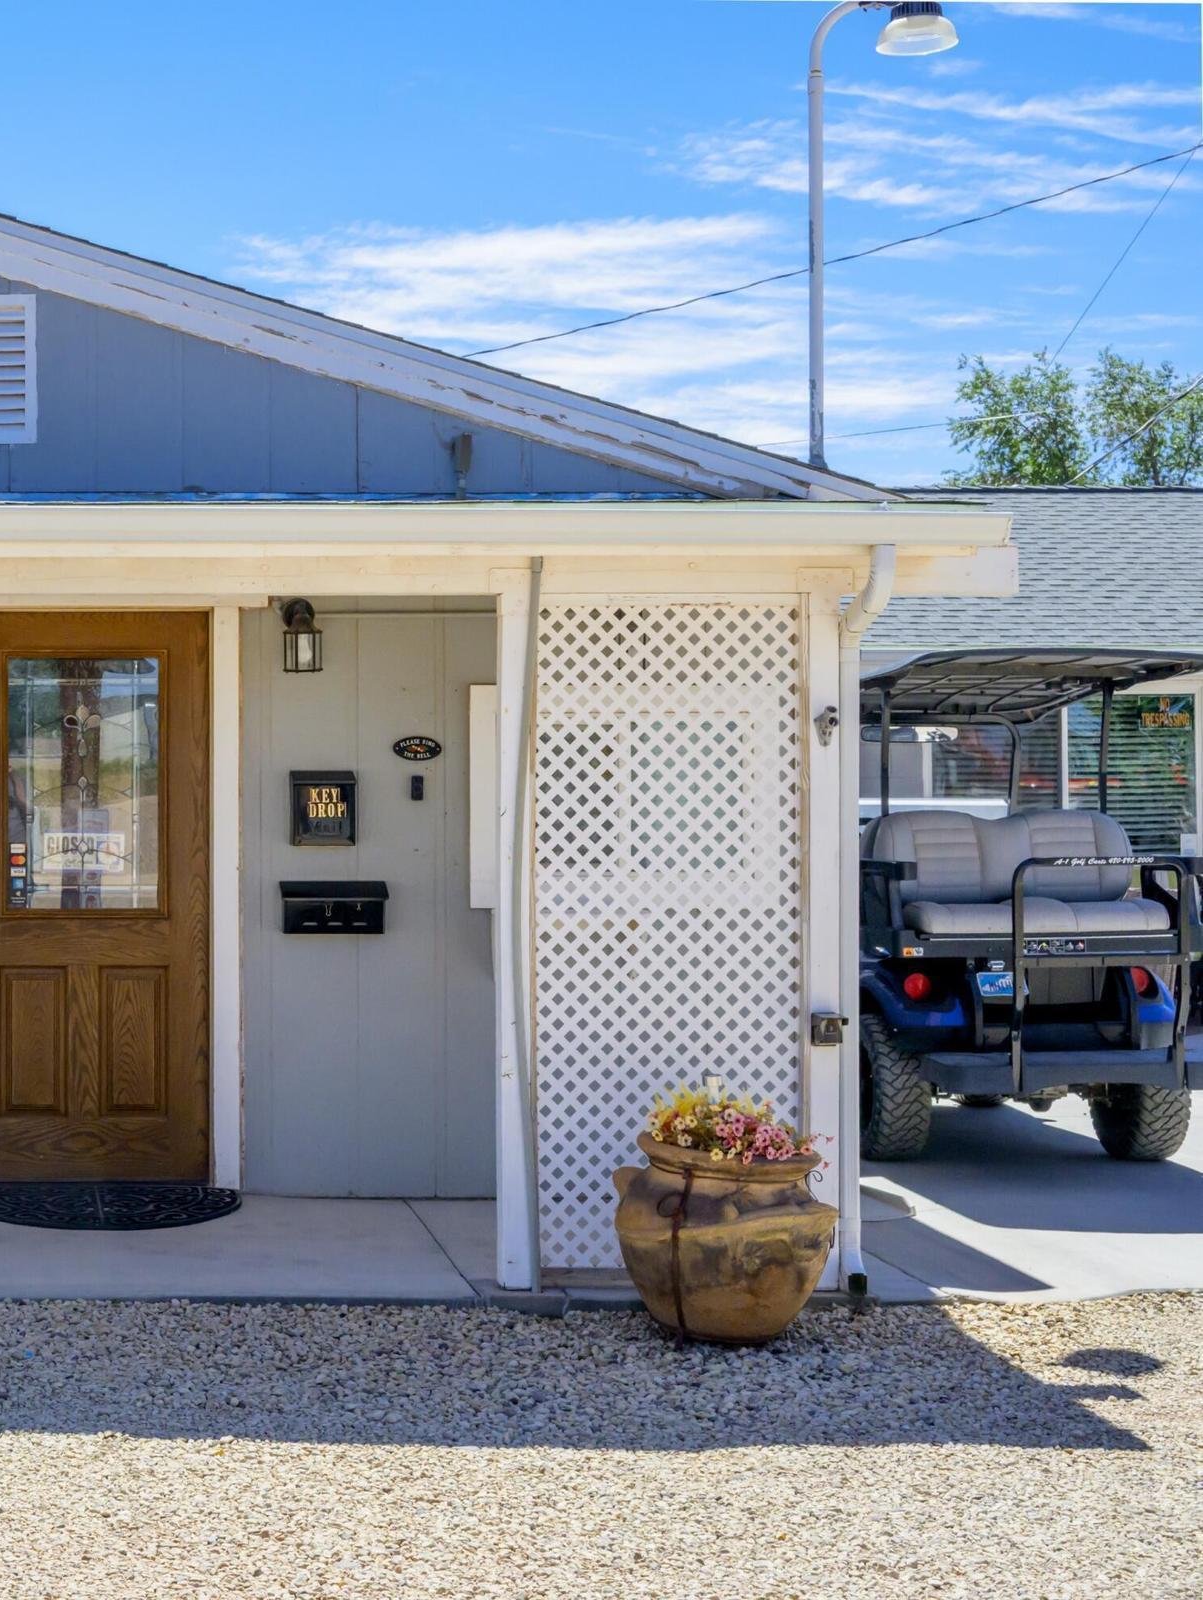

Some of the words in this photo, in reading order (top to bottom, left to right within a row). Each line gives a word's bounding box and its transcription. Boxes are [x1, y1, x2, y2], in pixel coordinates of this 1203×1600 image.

[1159, 696, 1170, 711] NO
[399, 738, 421, 748] PLEASE
[404, 751, 414, 759] THE
[309, 788, 339, 803] KEY
[308, 803, 346, 818] DROP
[46, 835, 95, 855] CLOSD
[1070, 858, 1086, 867] Golf
